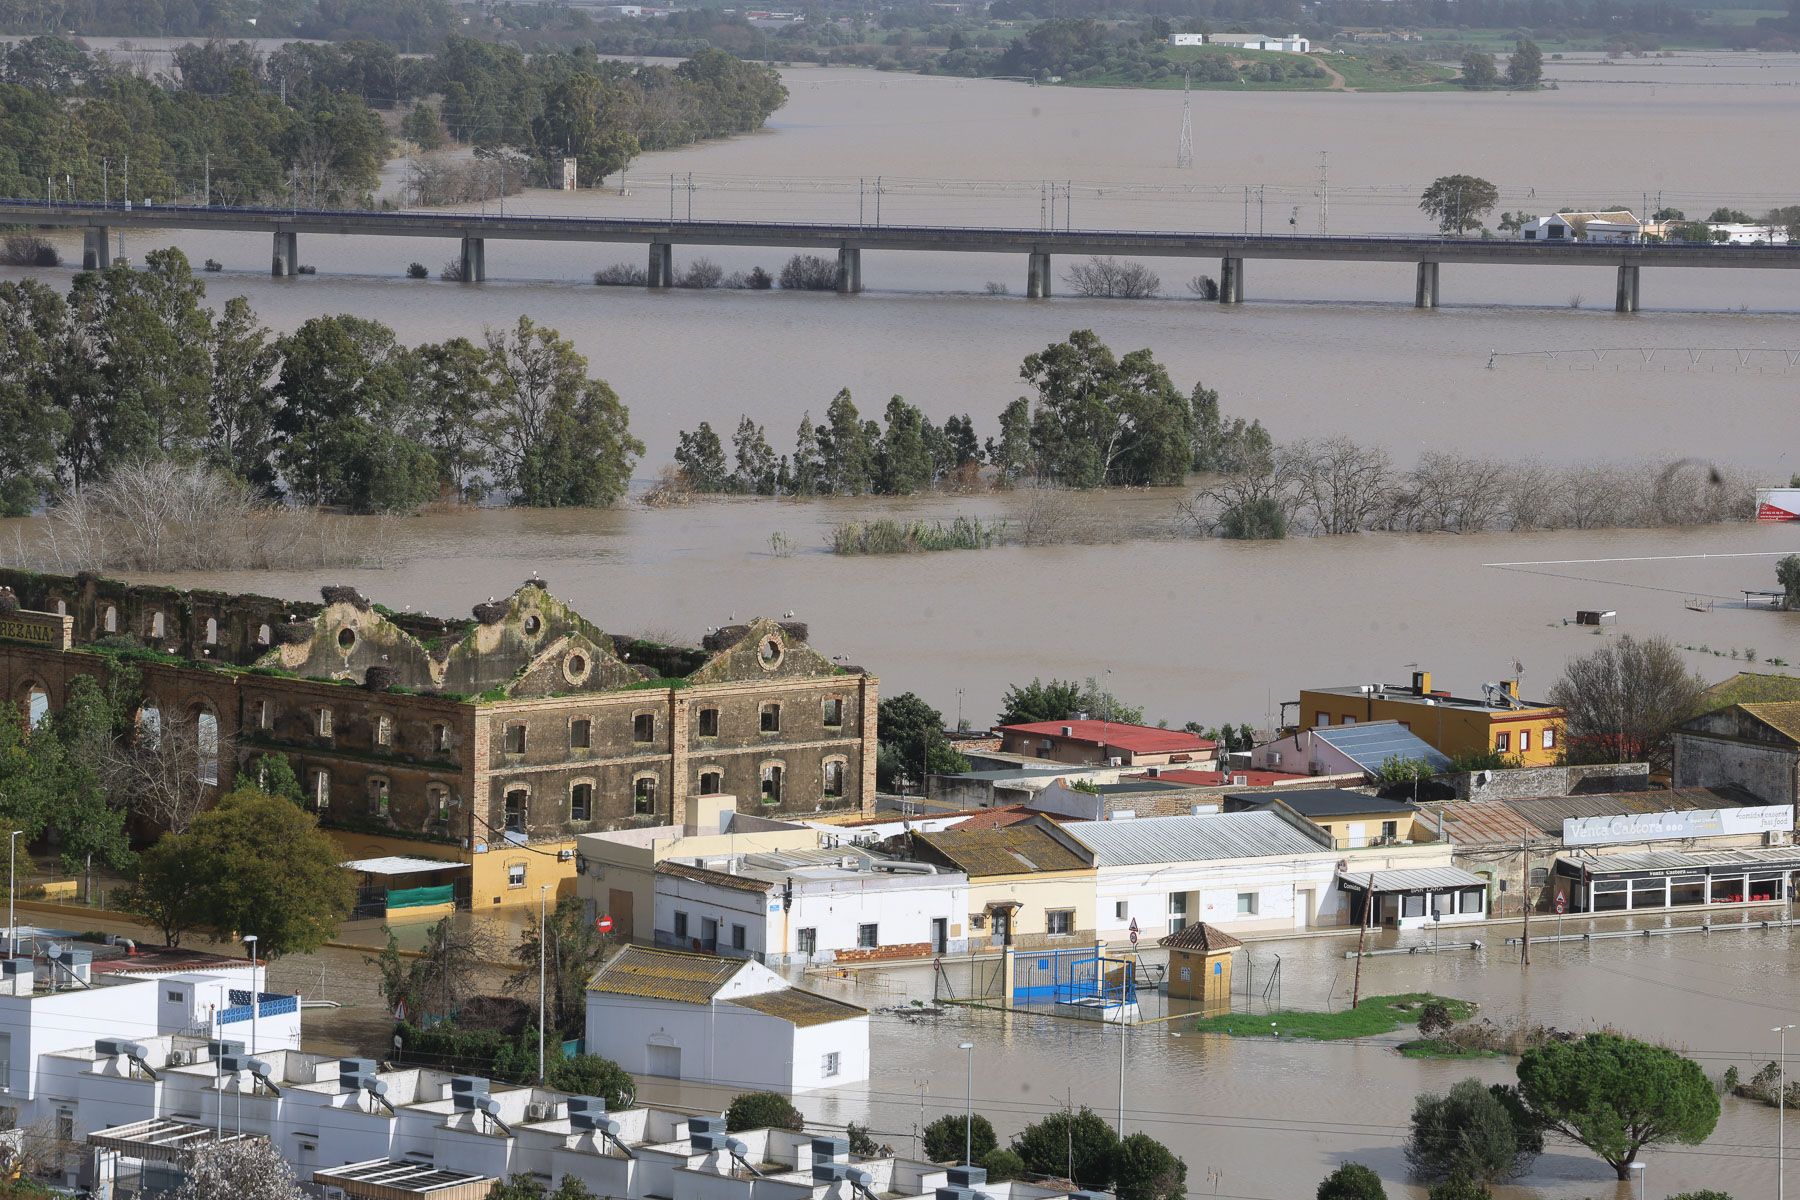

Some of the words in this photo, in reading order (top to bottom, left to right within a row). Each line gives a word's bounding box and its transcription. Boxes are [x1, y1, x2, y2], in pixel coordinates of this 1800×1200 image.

[1773, 817, 1787, 827] food
[1570, 823, 1609, 838] Venta
[1612, 822, 1663, 835] Castora
